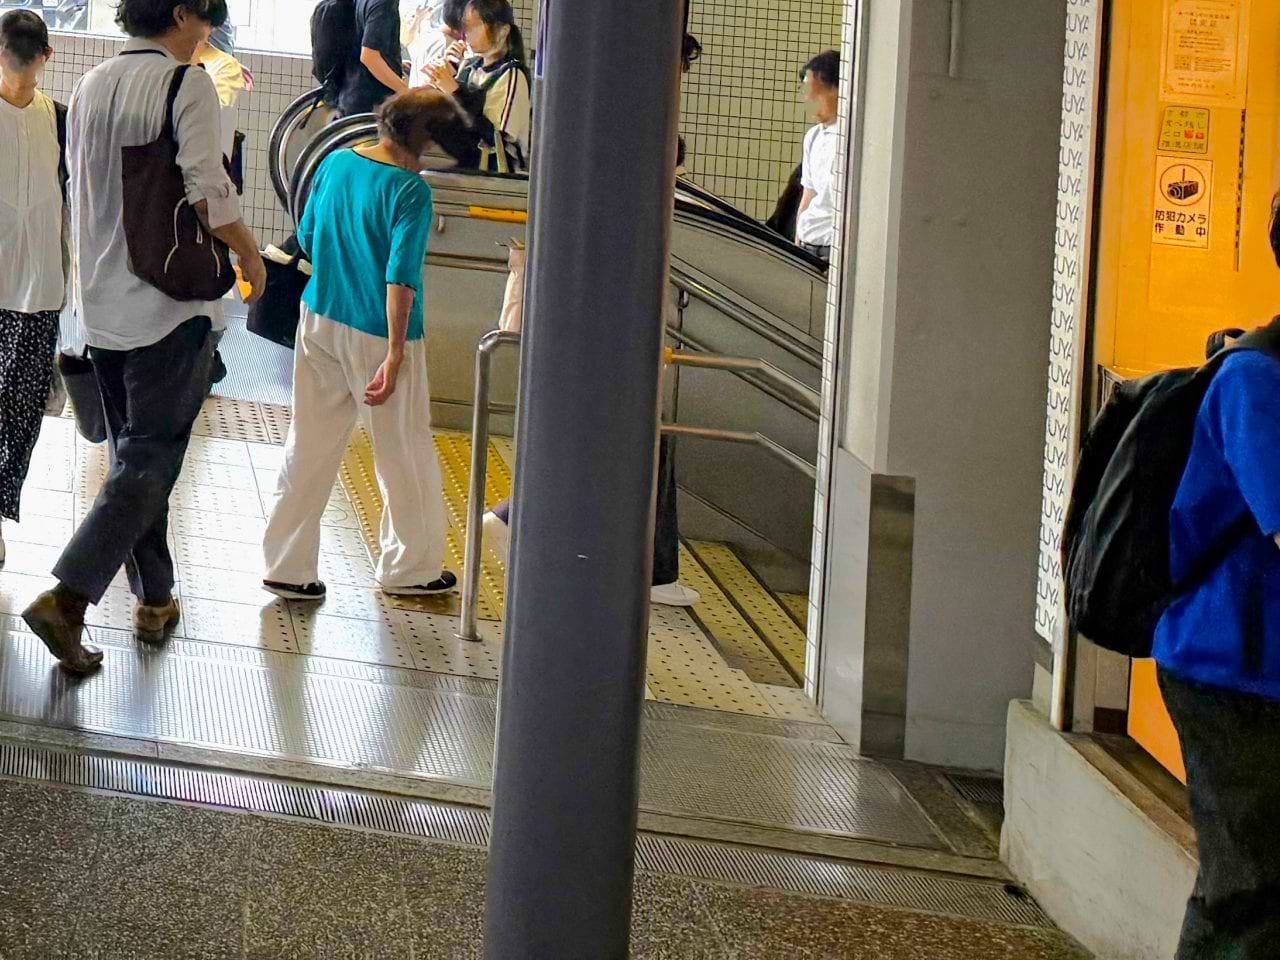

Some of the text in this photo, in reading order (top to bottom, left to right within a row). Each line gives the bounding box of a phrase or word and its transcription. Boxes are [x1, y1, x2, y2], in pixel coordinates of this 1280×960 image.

[1155, 209, 1207, 225] 防犯カメラ
[1154, 222, 1206, 237] 作動中
